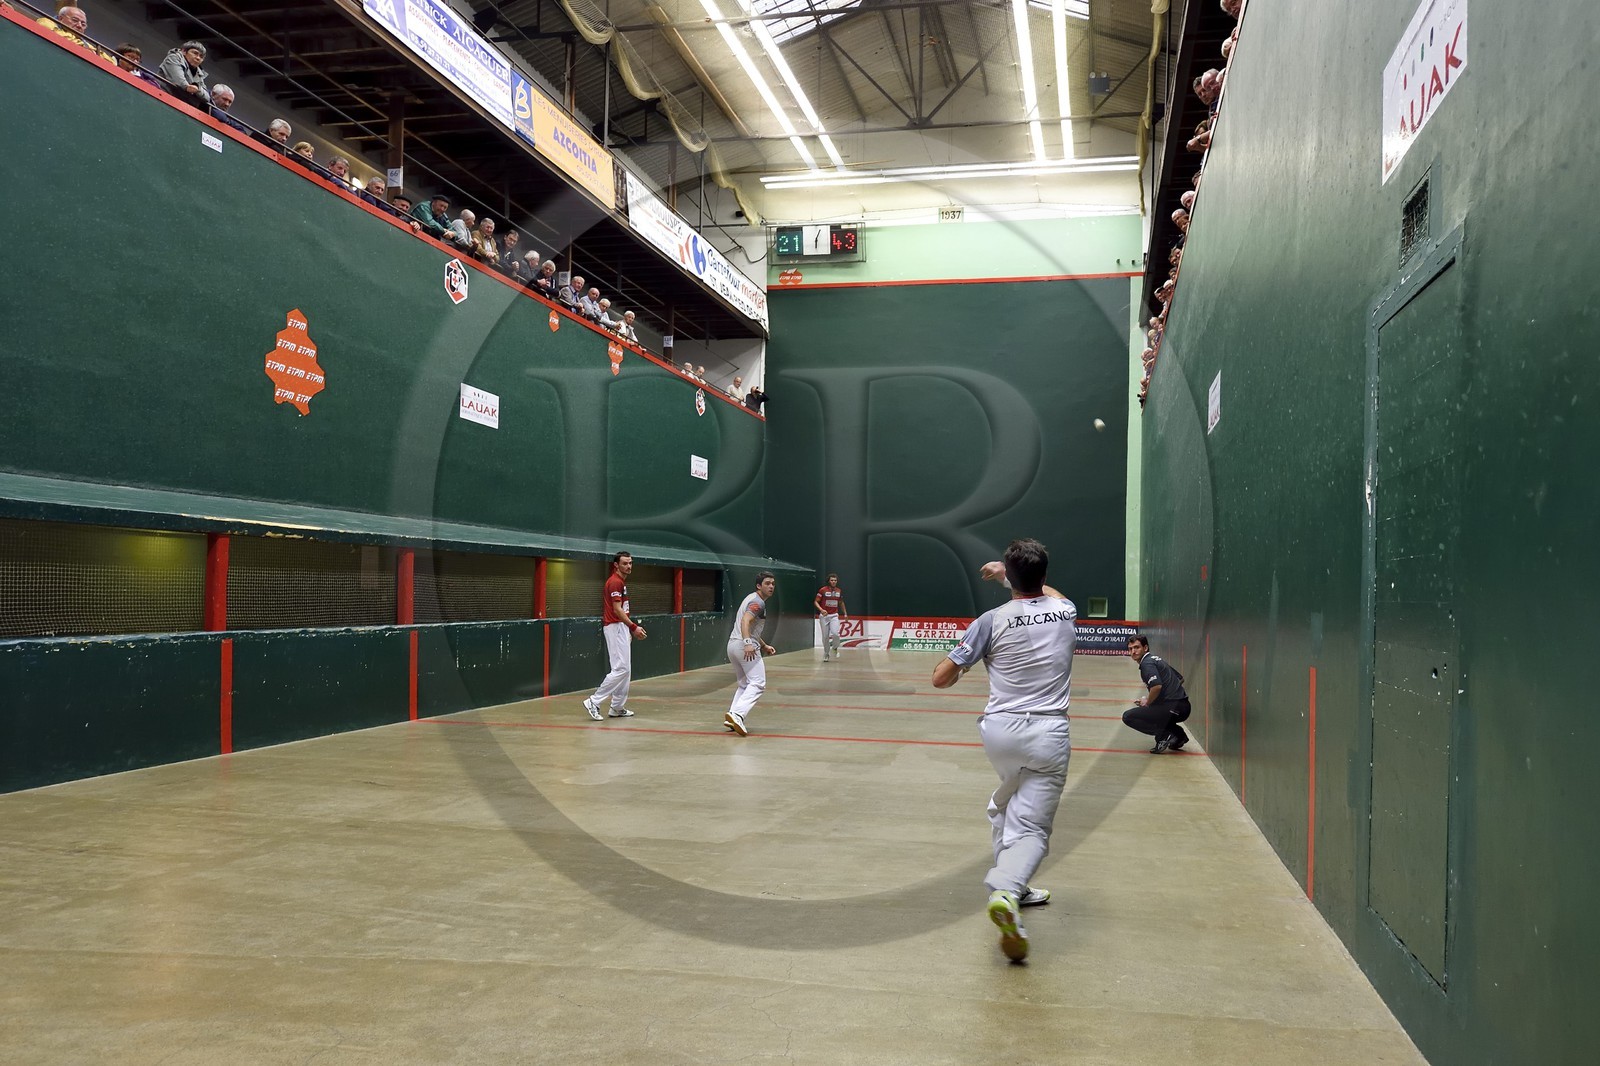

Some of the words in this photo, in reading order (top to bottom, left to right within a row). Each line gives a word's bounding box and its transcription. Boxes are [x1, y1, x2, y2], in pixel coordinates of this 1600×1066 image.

[553, 126, 598, 175] AZCOITIA
[941, 210, 961, 220] 1937
[779, 235, 799, 252] 21
[833, 232, 855, 250] 43
[707, 248, 741, 291] Carrefour
[741, 282, 765, 309] market
[288, 318, 307, 331] ETPM
[276, 338, 296, 352] ETPM
[297, 345, 316, 358] ETPM
[265, 359, 286, 373] ETPM
[286, 366, 305, 379] ETPM
[306, 372, 324, 384] ETPM
[275, 388, 295, 400] ETPM
[295, 393, 312, 404] ETP
[461, 398, 498, 419] LAUAK
[839, 619, 864, 637] BA
[901, 621, 920, 629] NEUF
[1007, 610, 1071, 629] LAZCANO
[915, 630, 957, 638] GARAZI
